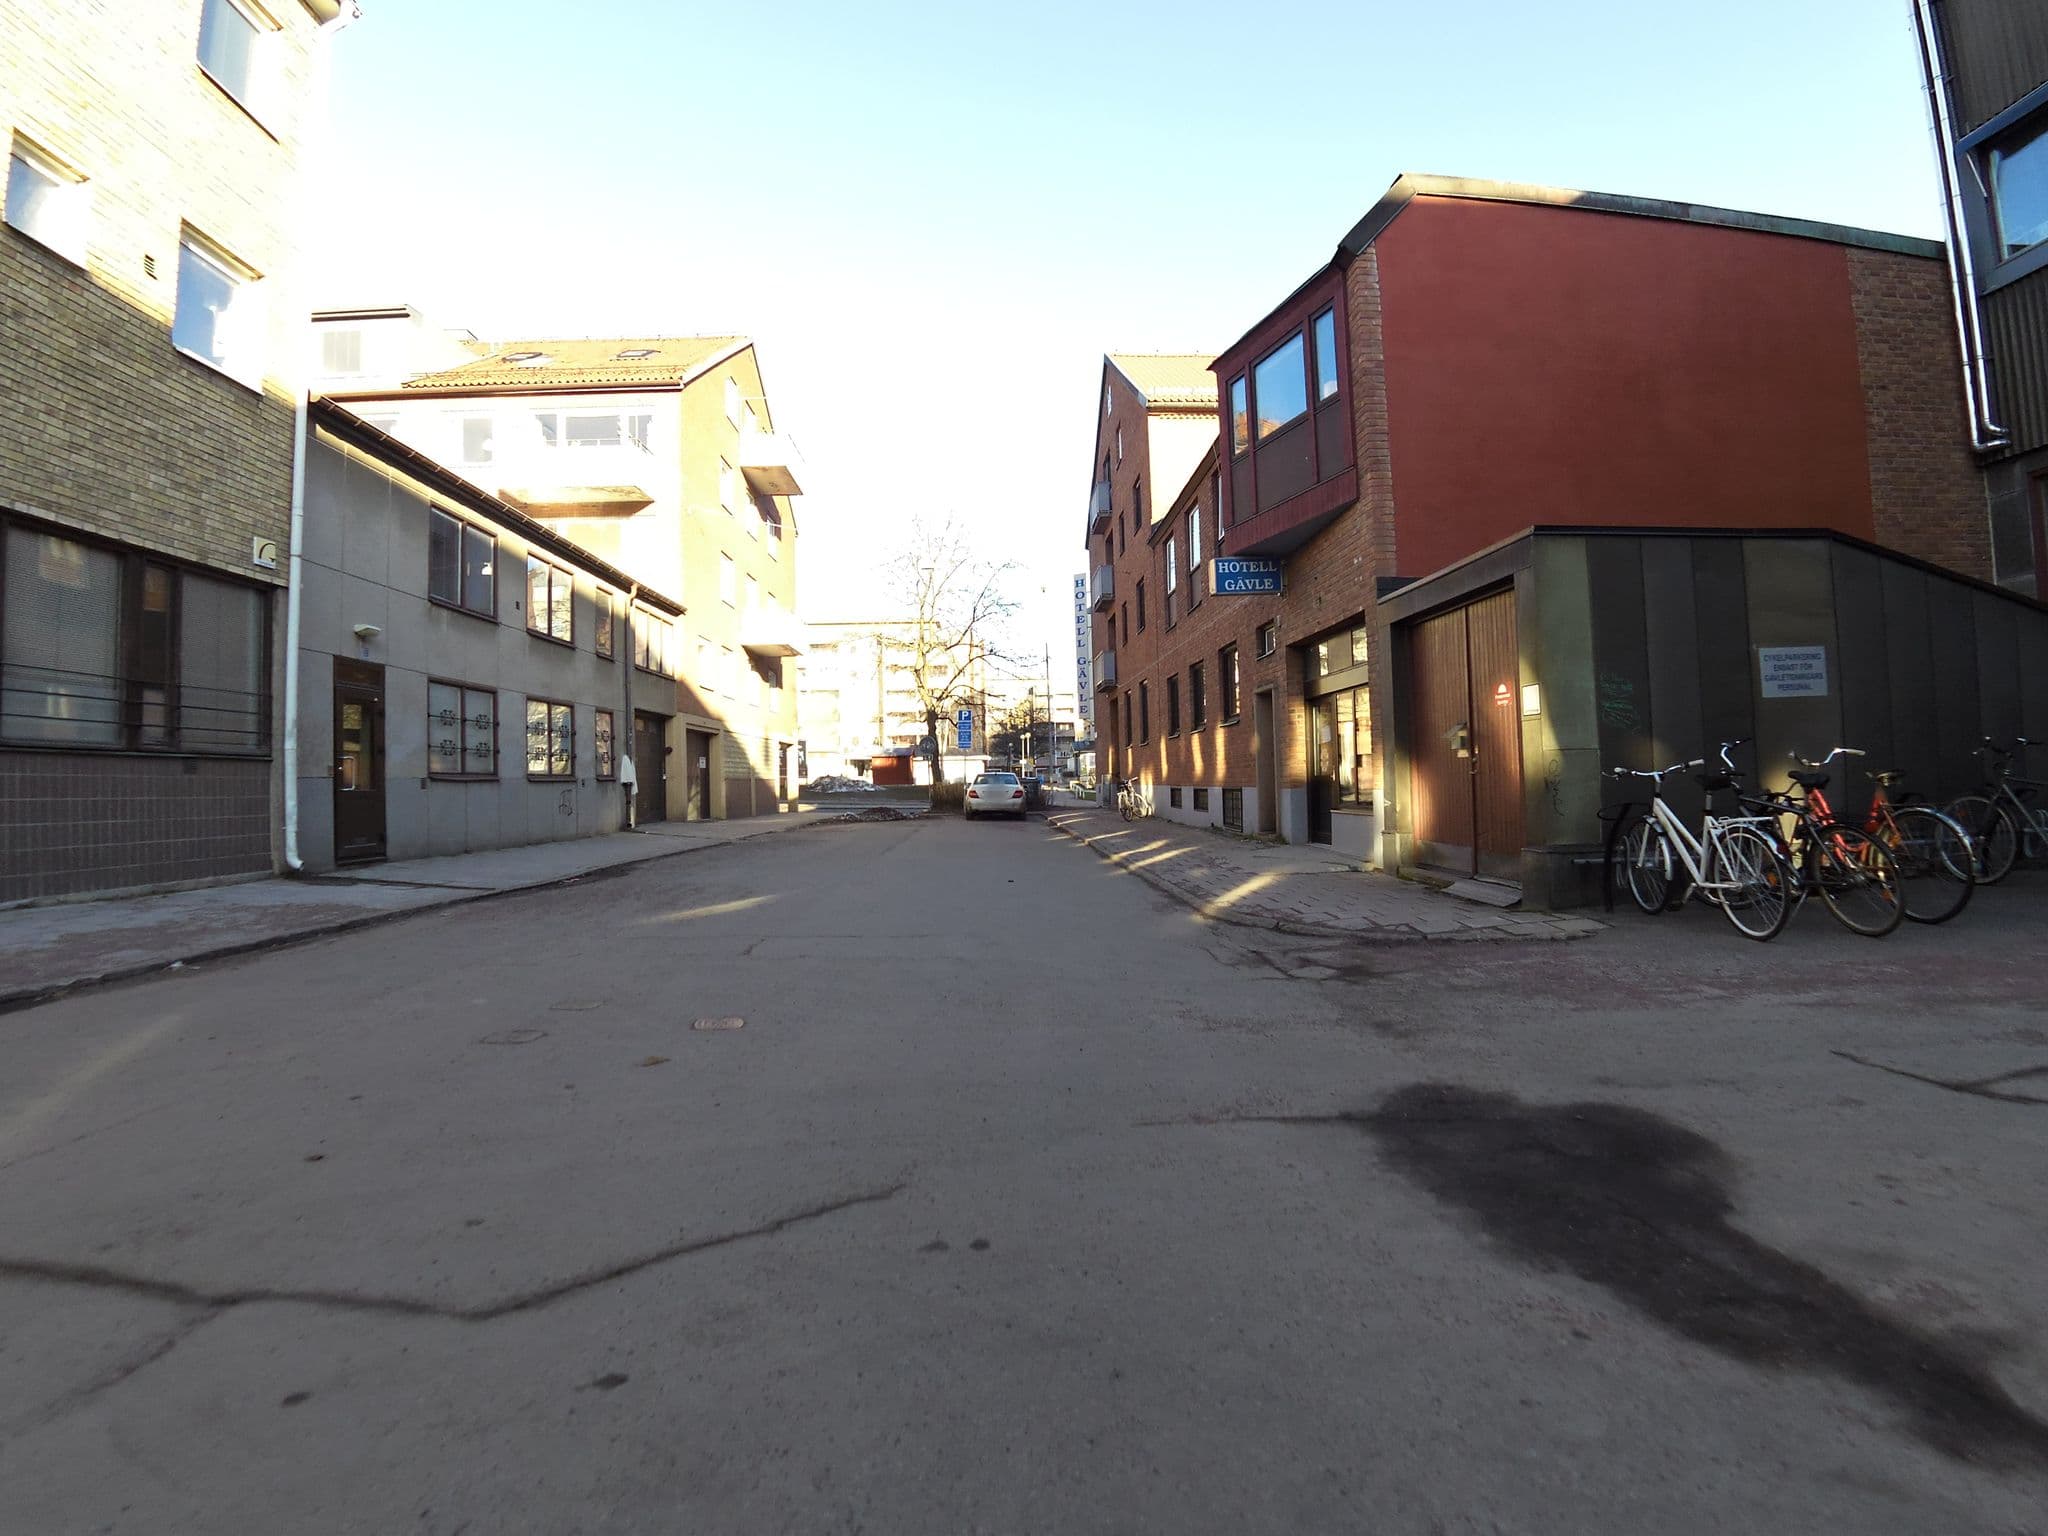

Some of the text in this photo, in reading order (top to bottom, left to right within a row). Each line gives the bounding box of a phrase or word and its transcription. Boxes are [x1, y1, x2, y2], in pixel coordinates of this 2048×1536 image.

[1217, 561, 1277, 573] HOTELL
[1224, 576, 1274, 591] GÄVLE
[1075, 579, 1088, 713] HOTELL GÄVLE
[961, 711, 969, 721] P
